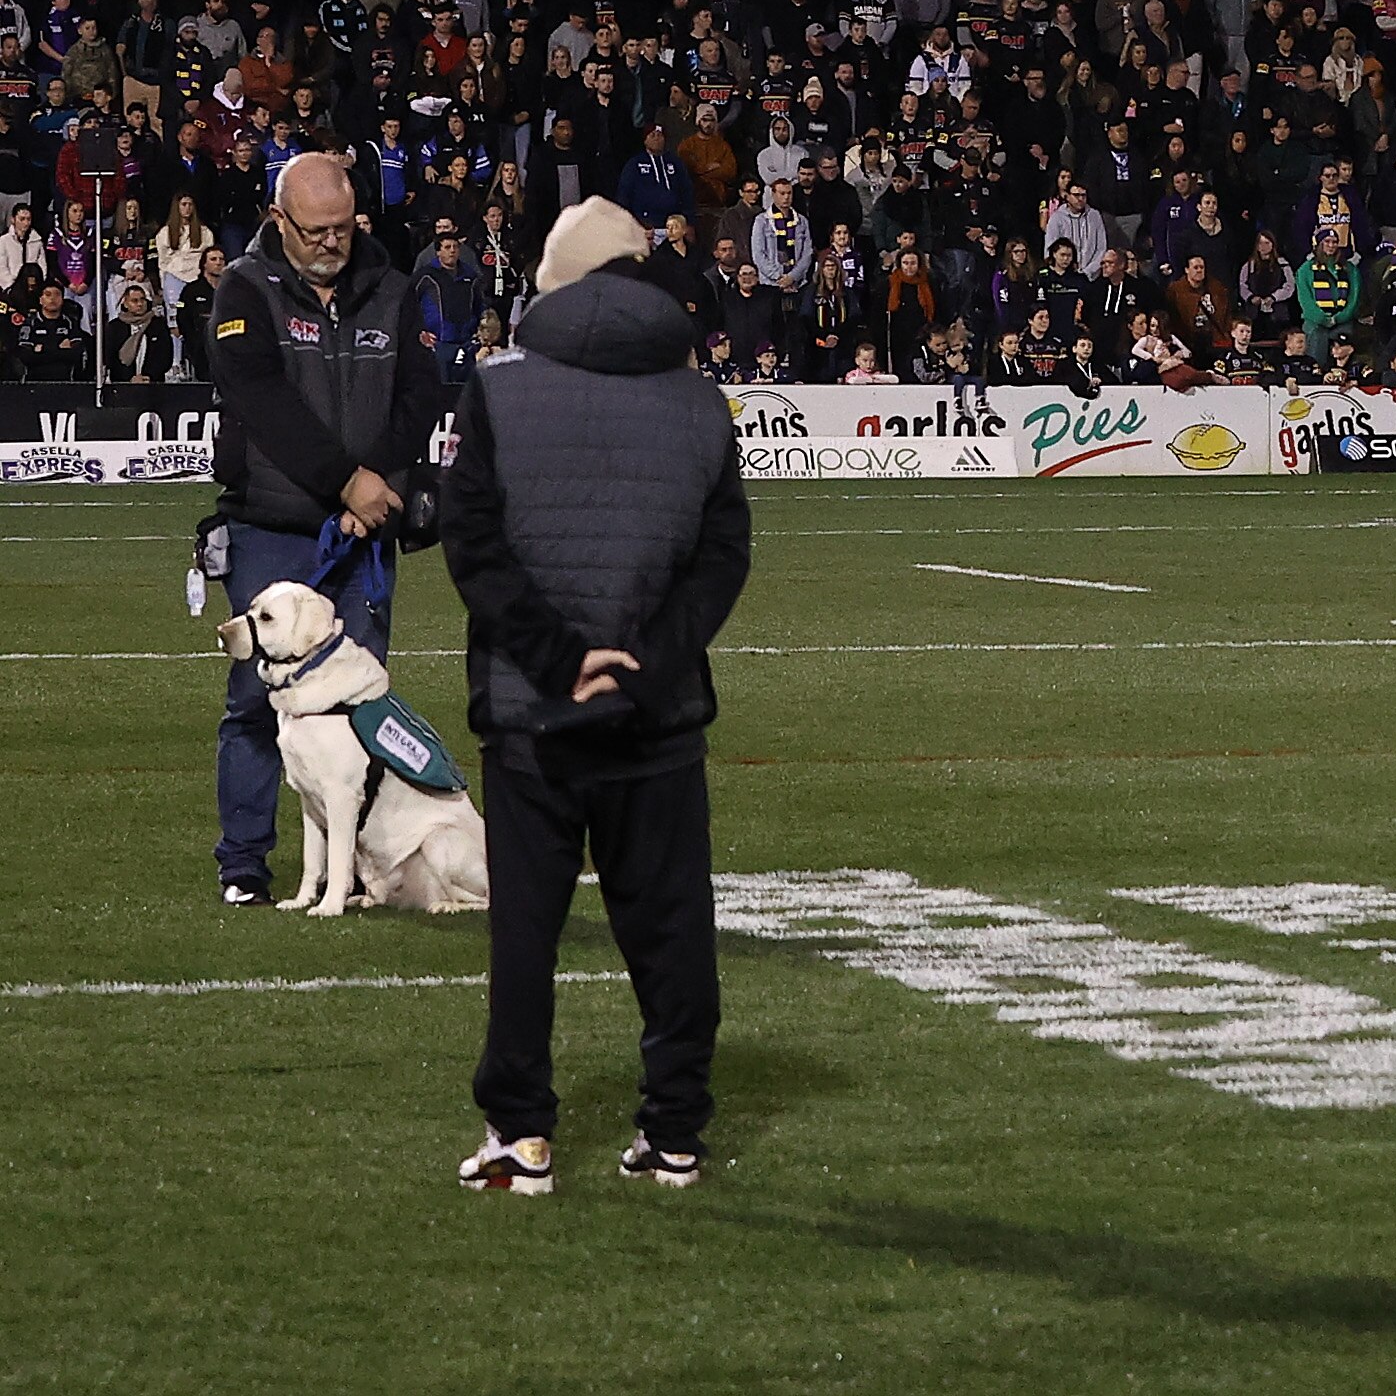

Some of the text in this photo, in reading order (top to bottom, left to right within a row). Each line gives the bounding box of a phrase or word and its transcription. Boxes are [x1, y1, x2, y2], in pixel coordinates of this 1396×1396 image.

[1023, 398, 1147, 468] Pies
[20, 445, 82, 460] CASELLA
[146, 443, 208, 457] CASELLA
[0, 456, 105, 483] EXPRESS
[757, 469, 813, 478] SOLUTIONS
[865, 469, 923, 479] Since 1959
